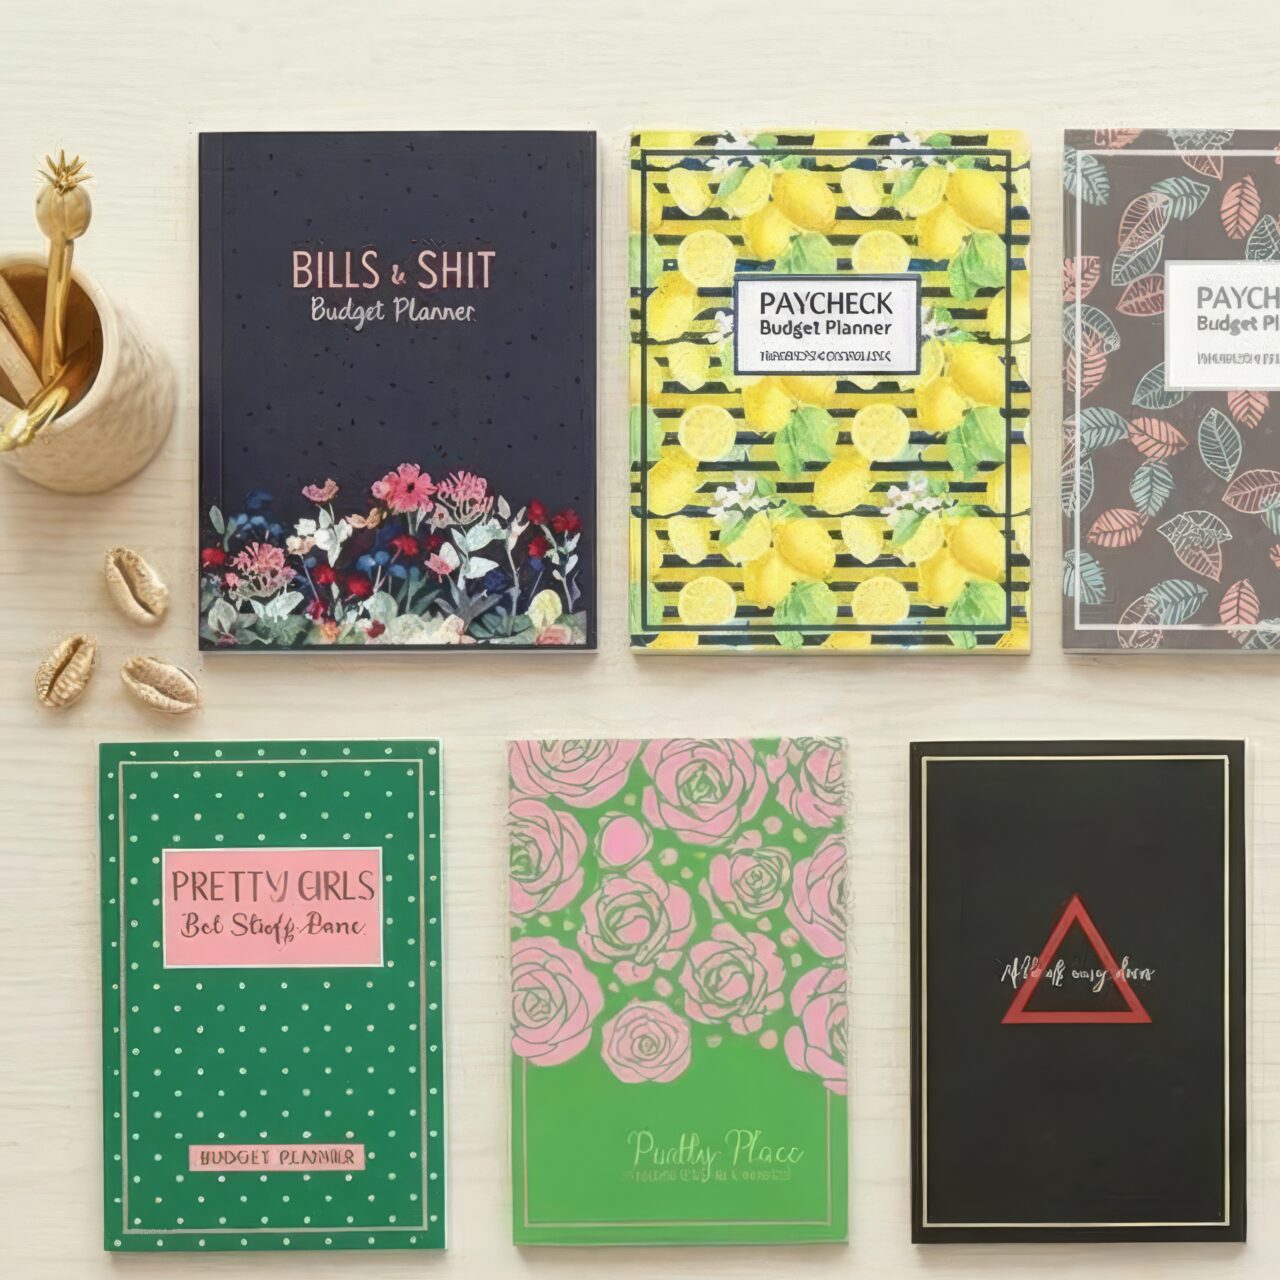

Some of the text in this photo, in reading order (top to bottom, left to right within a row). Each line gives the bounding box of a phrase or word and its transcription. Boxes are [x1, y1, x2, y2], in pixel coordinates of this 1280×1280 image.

[292, 250, 380, 290] BILLS
[417, 249, 496, 290] SHIT
[311, 296, 477, 332] Budget Planner
[759, 291, 893, 315] PAYCHECK
[760, 320, 892, 340] Budget Planner
[1197, 314, 1258, 336] Budget
[171, 870, 375, 903] PRETTY GIRLS
